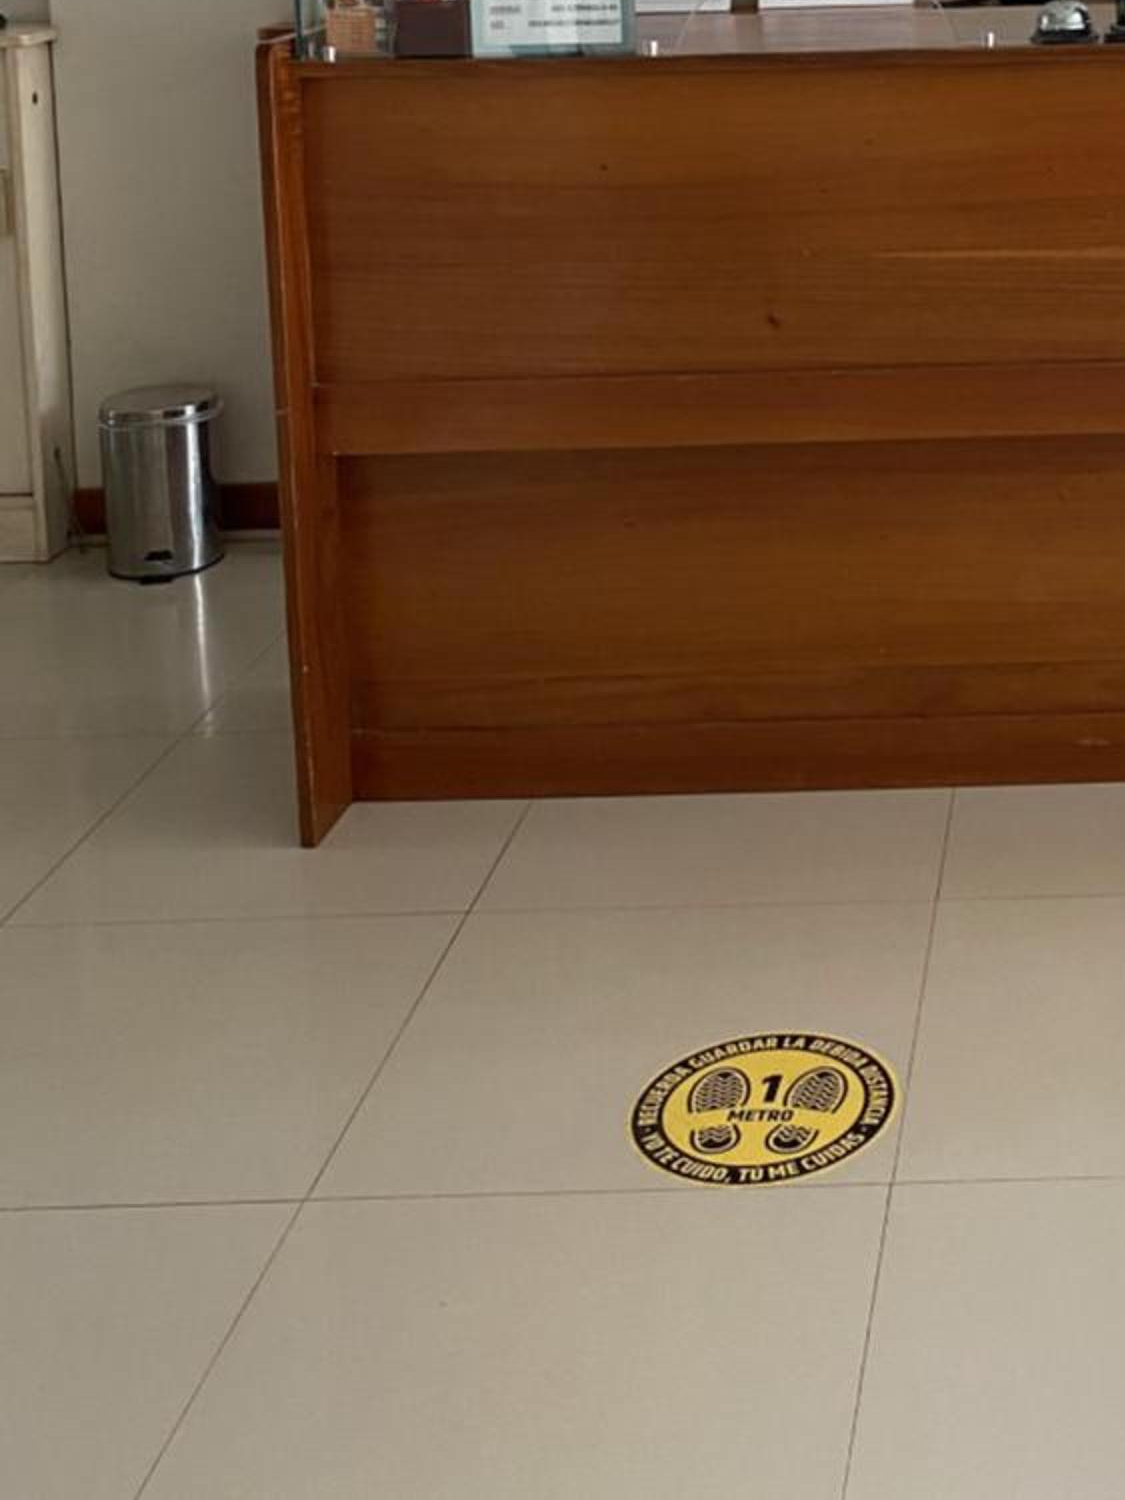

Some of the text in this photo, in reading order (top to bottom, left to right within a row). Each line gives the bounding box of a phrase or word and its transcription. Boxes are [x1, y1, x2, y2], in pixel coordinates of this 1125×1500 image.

[689, 1036, 778, 1069] GUARDAR
[782, 1036, 806, 1049] LA
[808, 1037, 869, 1068] DEBIDA
[762, 1073, 784, 1104] 1
[726, 1109, 795, 1123] METRO
[654, 1145, 679, 1165] TE
[670, 1157, 732, 1183] CUIDO,
[767, 1161, 800, 1180] ME
[800, 1131, 866, 1171] CUIDAS
